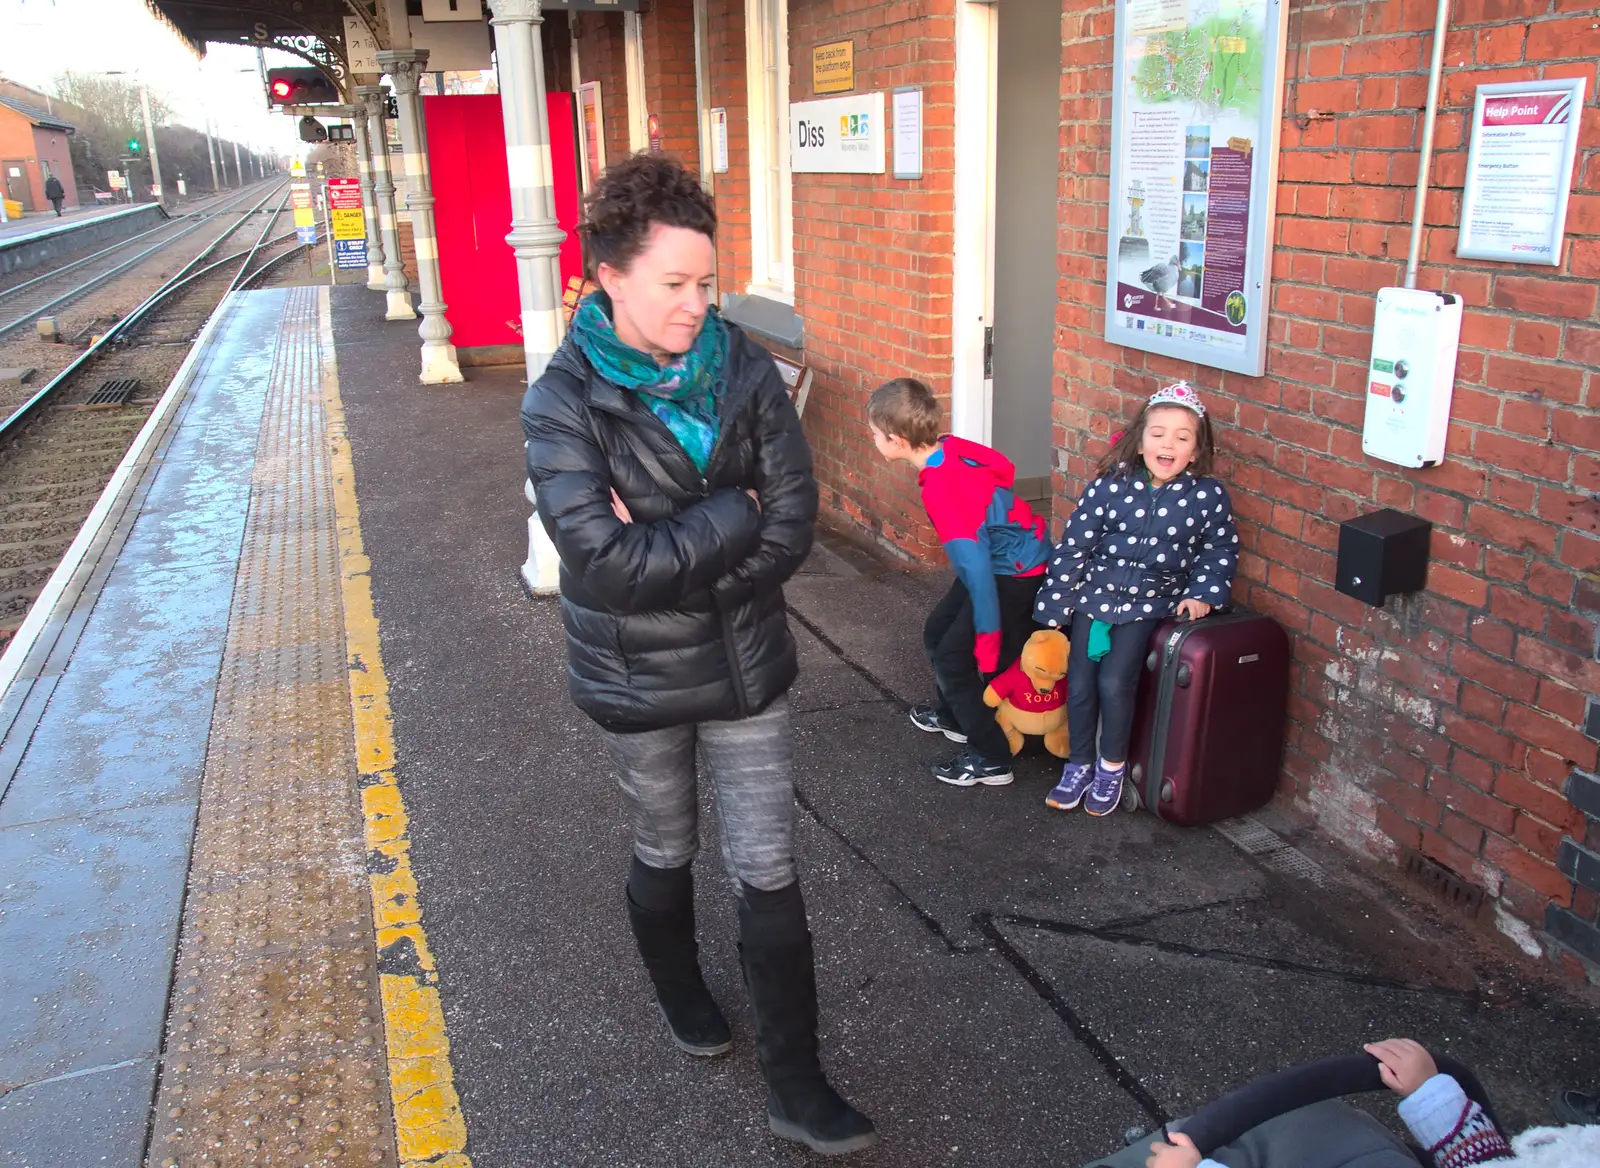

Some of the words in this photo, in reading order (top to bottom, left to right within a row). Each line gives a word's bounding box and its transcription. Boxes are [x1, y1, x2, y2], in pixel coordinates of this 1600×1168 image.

[254, 22, 268, 39] S
[1486, 106, 1508, 118] Help
[1511, 105, 1539, 116] Point
[798, 119, 825, 148] Diss
[1024, 689, 1059, 703] Pooh
